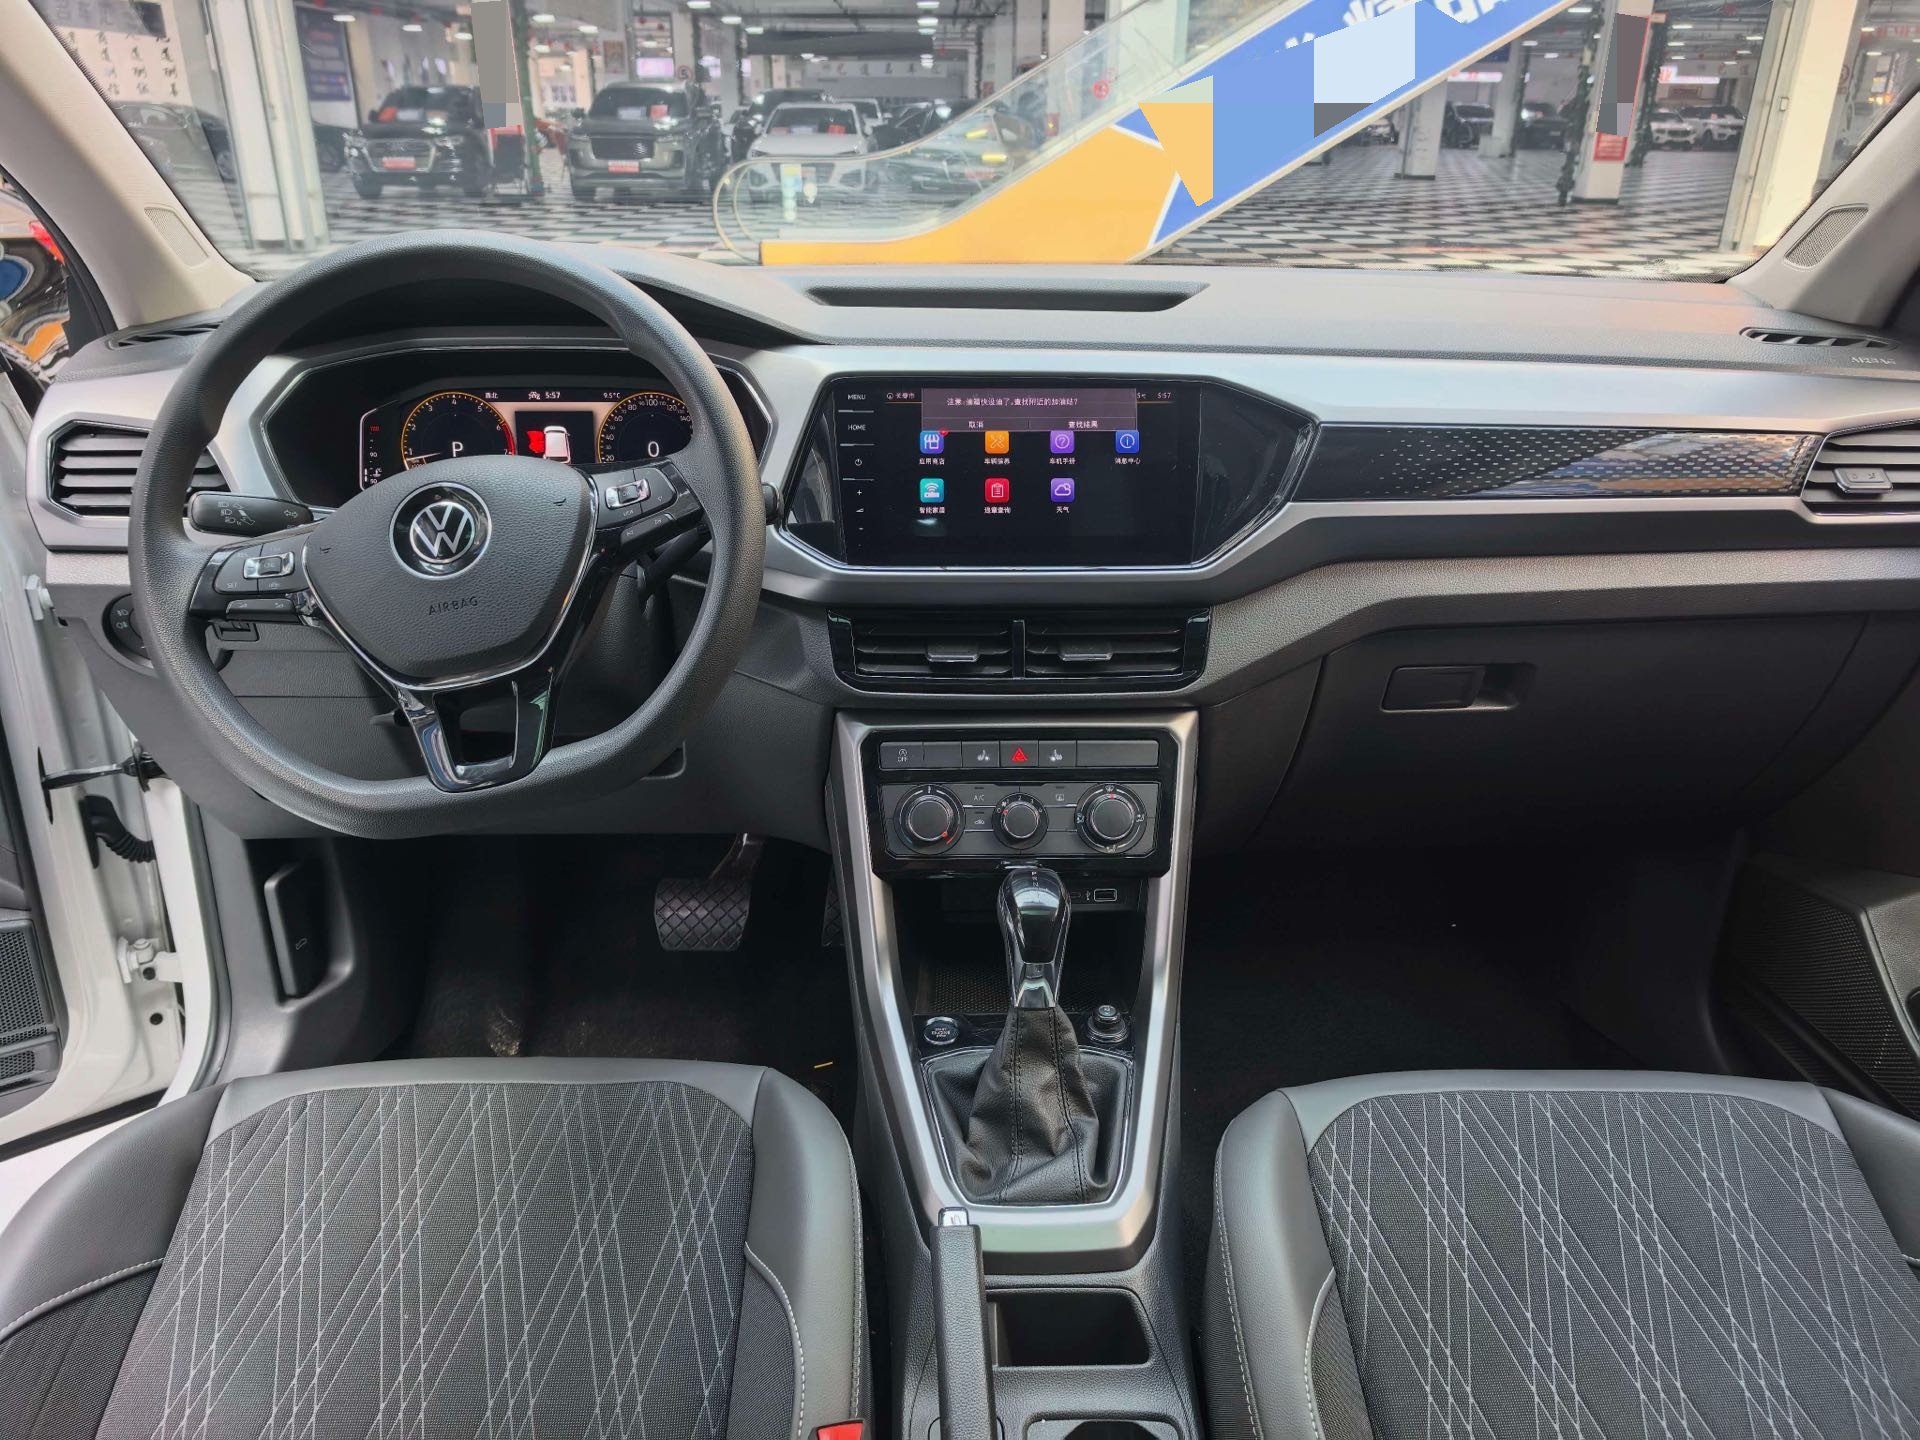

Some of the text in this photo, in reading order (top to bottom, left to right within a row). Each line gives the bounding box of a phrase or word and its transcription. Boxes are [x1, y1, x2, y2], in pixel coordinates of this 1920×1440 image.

[545, 391, 561, 399] 5:57
[667, 404, 677, 412] 120
[968, 421, 984, 429] 取消
[1068, 421, 1098, 429] 查找结果
[605, 433, 614, 441] 40
[451, 441, 464, 457] P
[647, 441, 660, 458] 0
[919, 457, 945, 465] 应用商店
[983, 457, 1010, 465] 车辆保养
[1049, 457, 1076, 465] 车机手册
[1114, 457, 1141, 465] 消息中心
[919, 506, 946, 514] 智能家居
[983, 506, 1011, 514] 违章查询
[1056, 506, 1070, 514] 天气
[428, 596, 479, 616] AIRBAG
[973, 794, 985, 802] A/C
